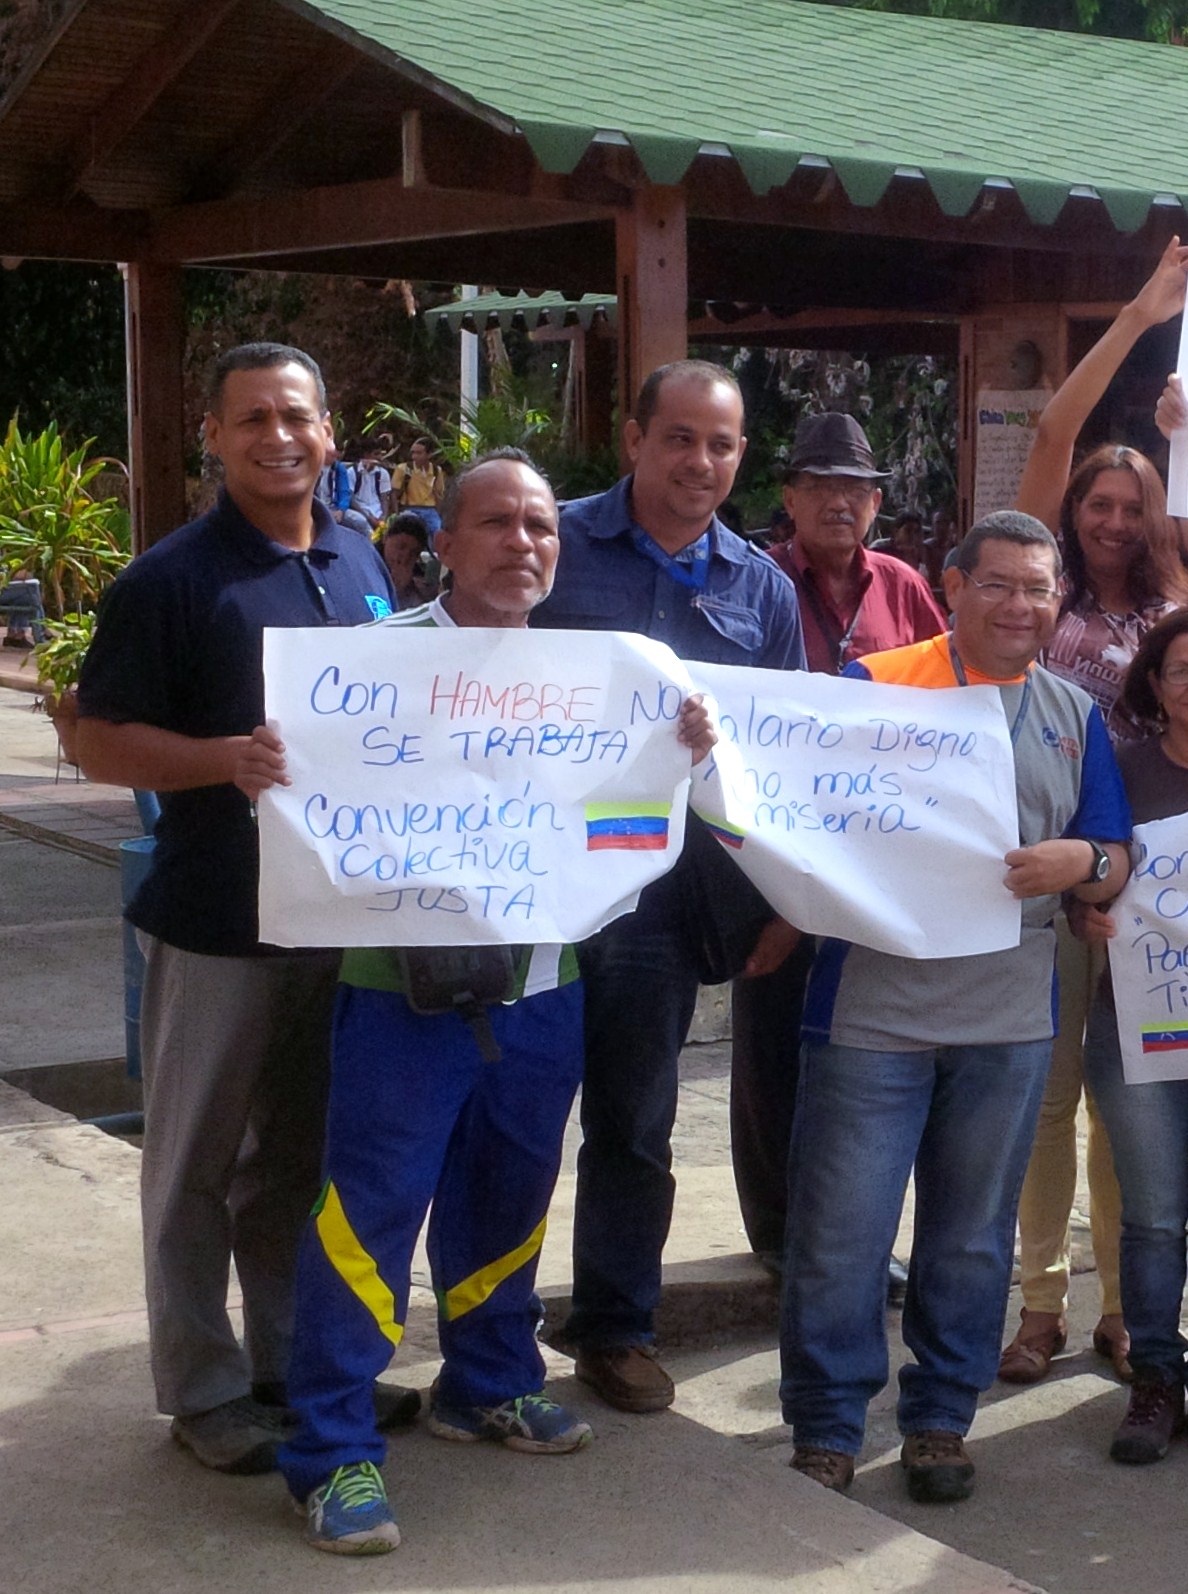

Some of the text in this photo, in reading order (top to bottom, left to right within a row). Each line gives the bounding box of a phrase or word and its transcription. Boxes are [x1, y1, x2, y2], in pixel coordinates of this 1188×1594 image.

[310, 666, 684, 726] Con HAMBRE NO
[363, 724, 629, 766] SE TRABAJA
[719, 695, 978, 772] alario Digno
[813, 764, 903, 797] más
[304, 781, 565, 841] Convención
[339, 836, 550, 881] Colectiva
[366, 884, 536, 920] JUSTA
